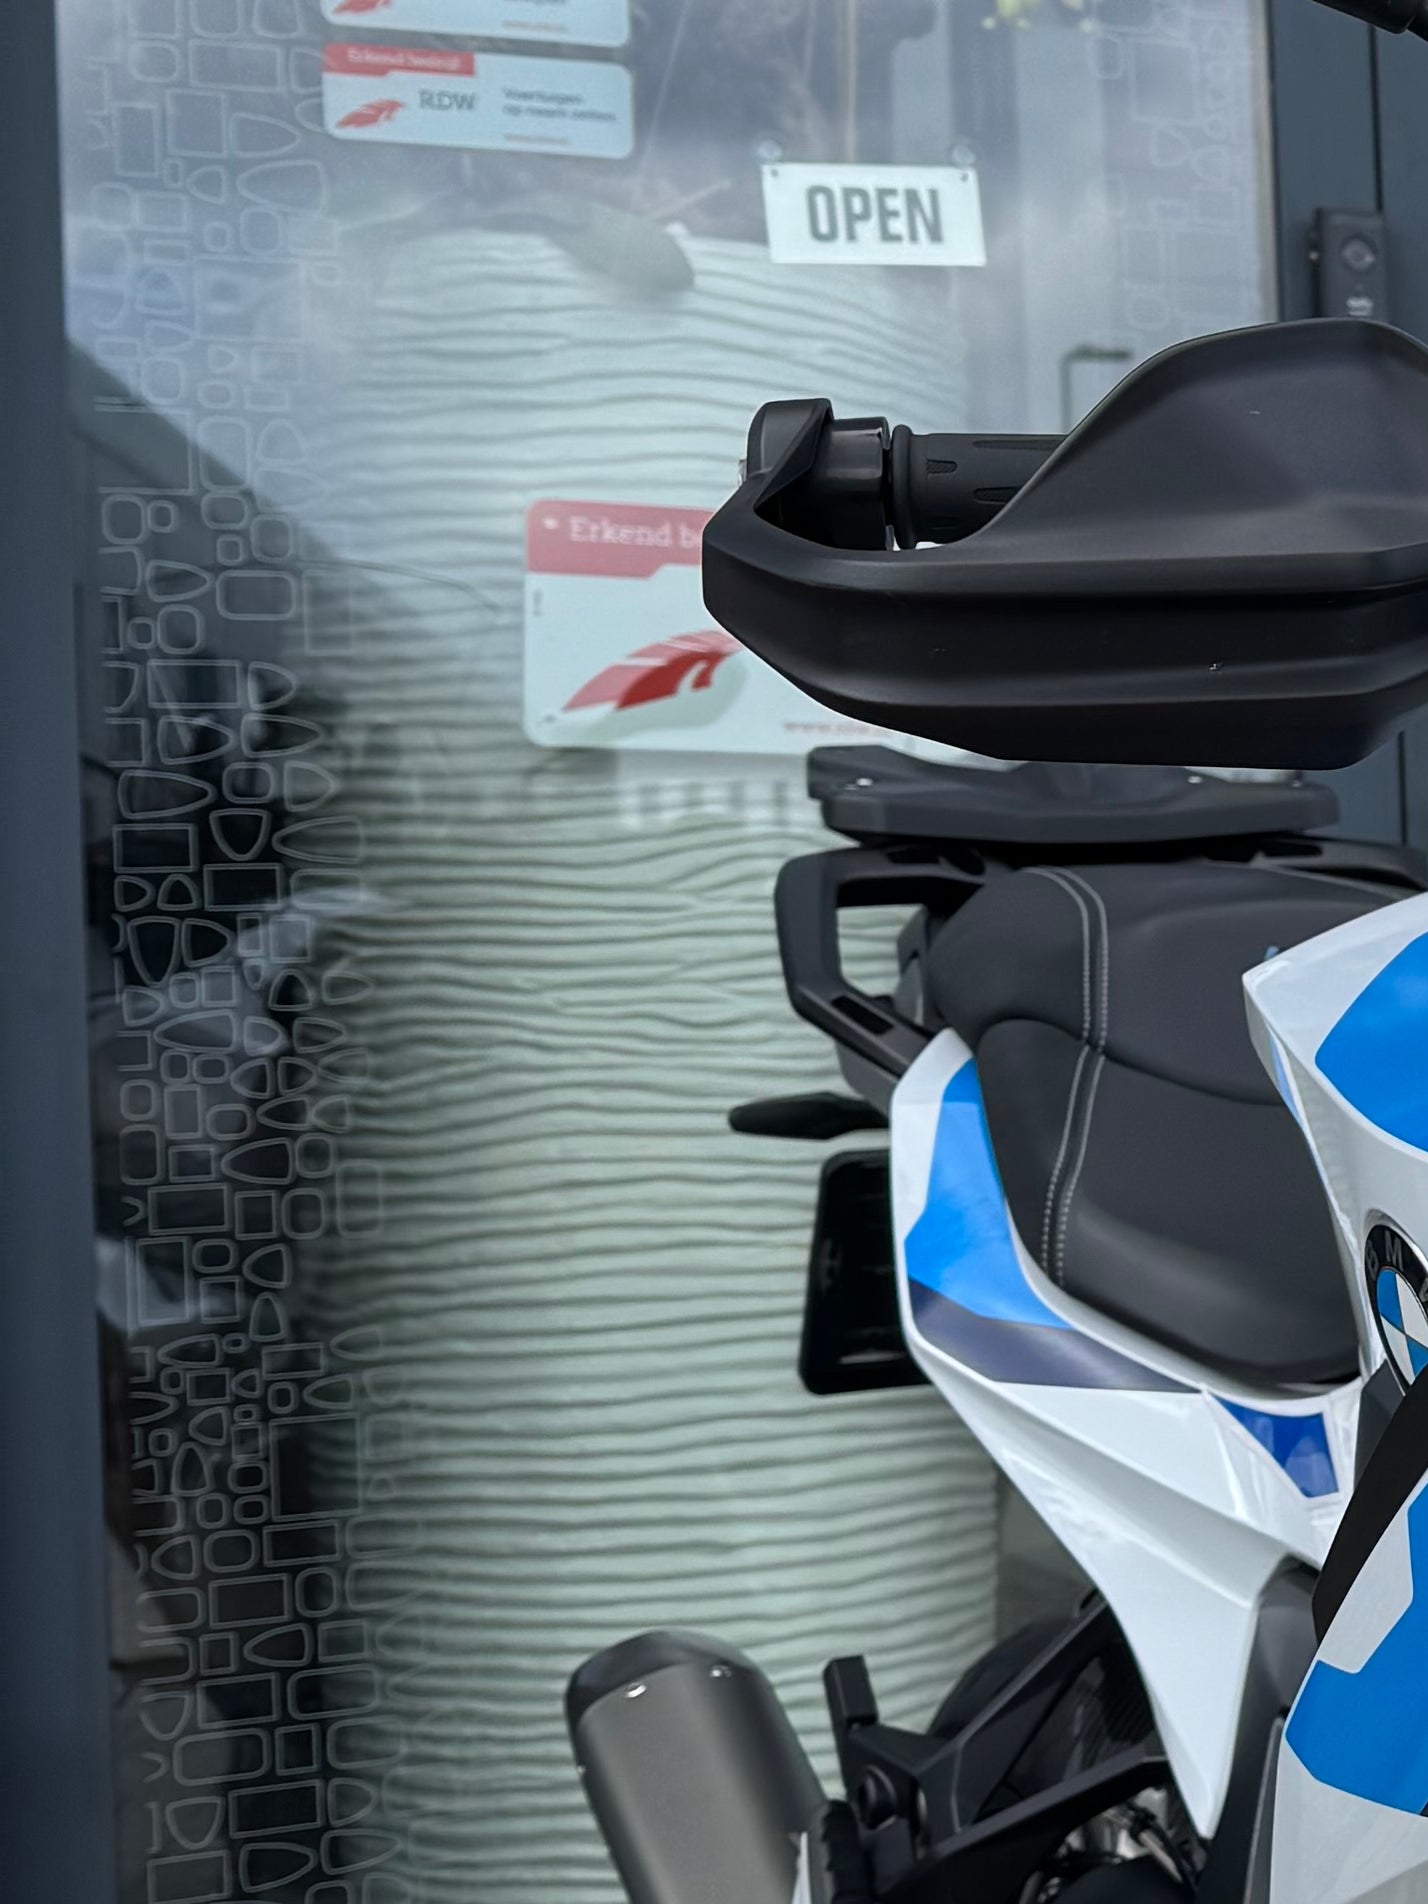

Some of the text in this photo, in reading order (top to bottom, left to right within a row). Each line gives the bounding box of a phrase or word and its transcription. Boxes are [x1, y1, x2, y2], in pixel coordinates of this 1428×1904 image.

[419, 88, 477, 112] RDW
[806, 185, 944, 243] OPEN
[568, 514, 671, 548] Erkend
